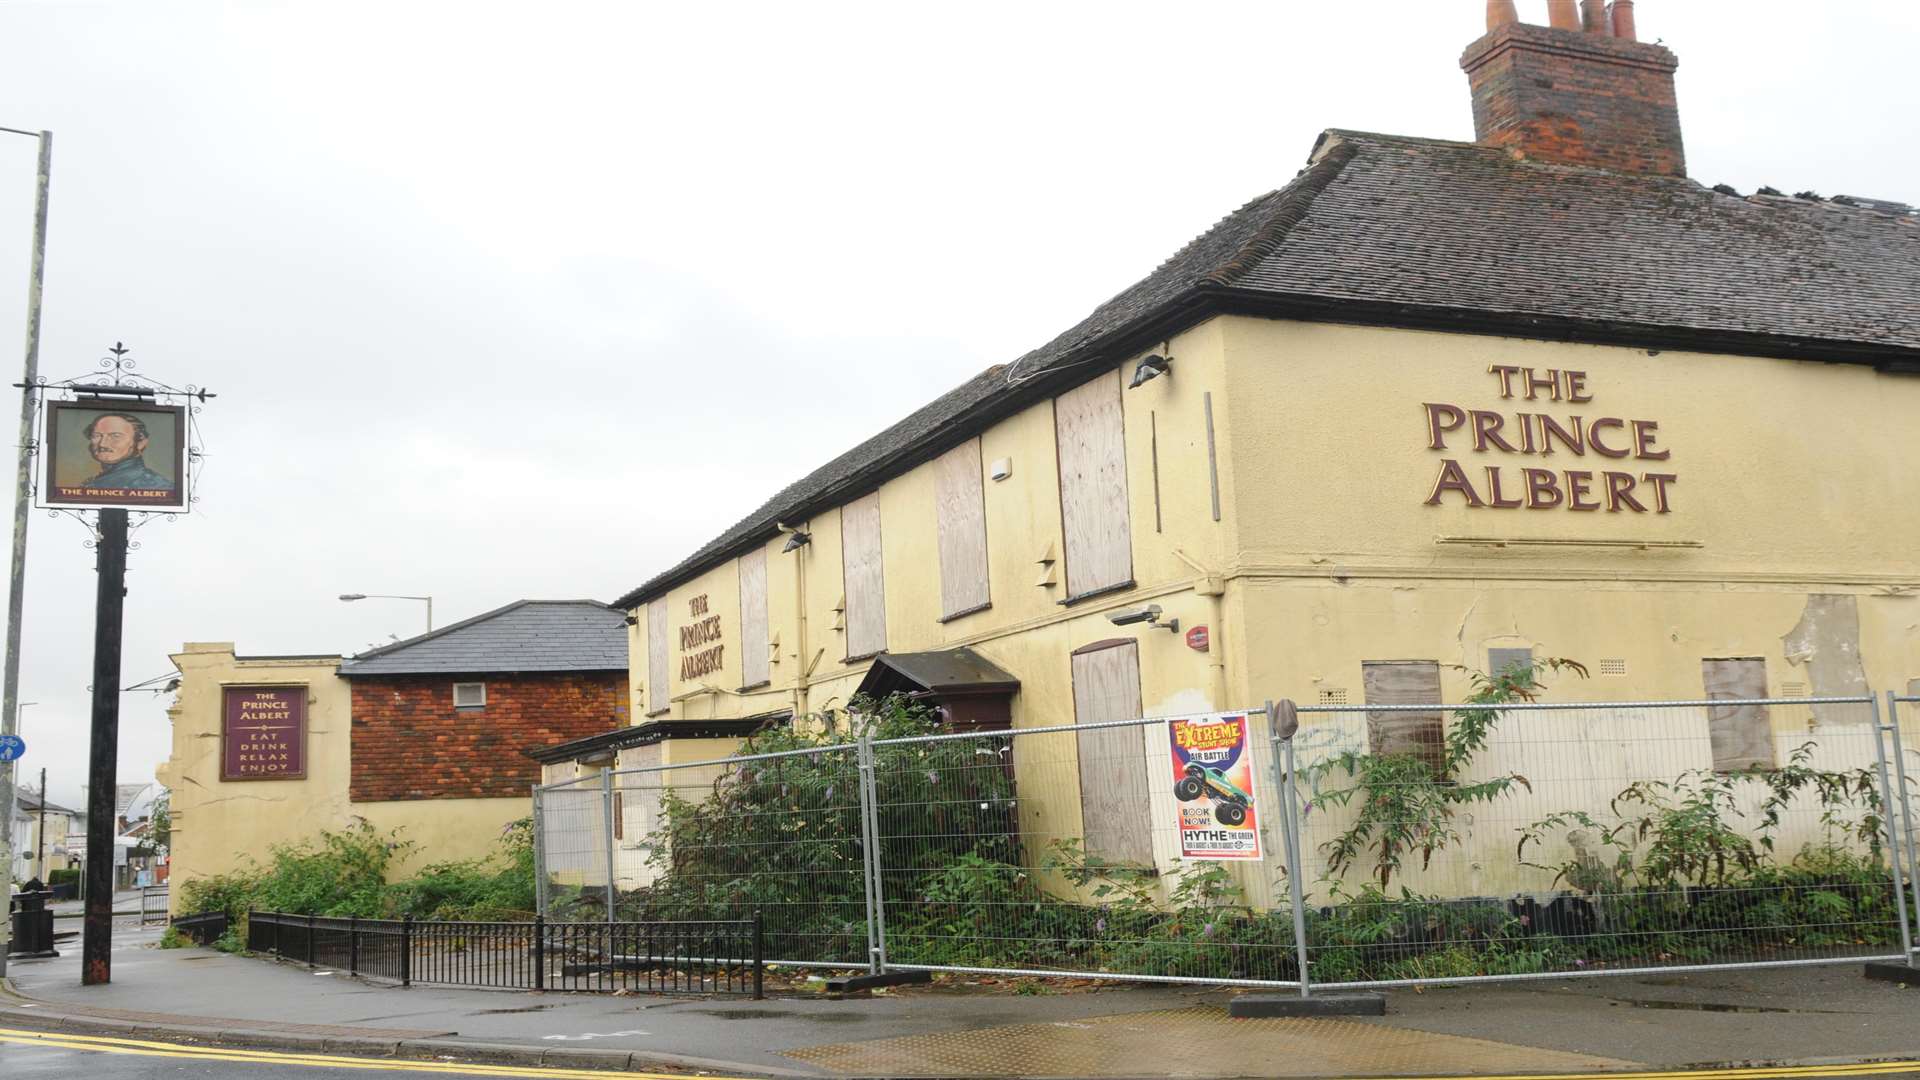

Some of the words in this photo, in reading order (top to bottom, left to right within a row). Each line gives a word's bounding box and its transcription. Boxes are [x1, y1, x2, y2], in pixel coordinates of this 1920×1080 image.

[1488, 364, 1593, 403] THE
[1422, 402, 1671, 461] PRINCE
[1423, 459, 1678, 513] ALBERT
[61, 488, 82, 496] THE
[86, 489, 126, 497] PRINCE
[688, 593, 708, 617] THE
[680, 614, 721, 651] PRINCE
[680, 644, 725, 682] ALBERT
[240, 711, 290, 719] ALBERT
[250, 733, 277, 741] EAT
[1176, 723, 1240, 746] EXTREME
[240, 743, 288, 751] DRINK
[240, 753, 288, 761] RELAX
[1190, 752, 1202, 761] AIR
[1203, 751, 1230, 761] BATTLE
[240, 763, 288, 772] ENJOY
[1182, 807, 1209, 816] BOOK
[1184, 818, 1211, 826] NOW!
[1184, 830, 1228, 841] HYTHE
[1228, 831, 1237, 840] THE
